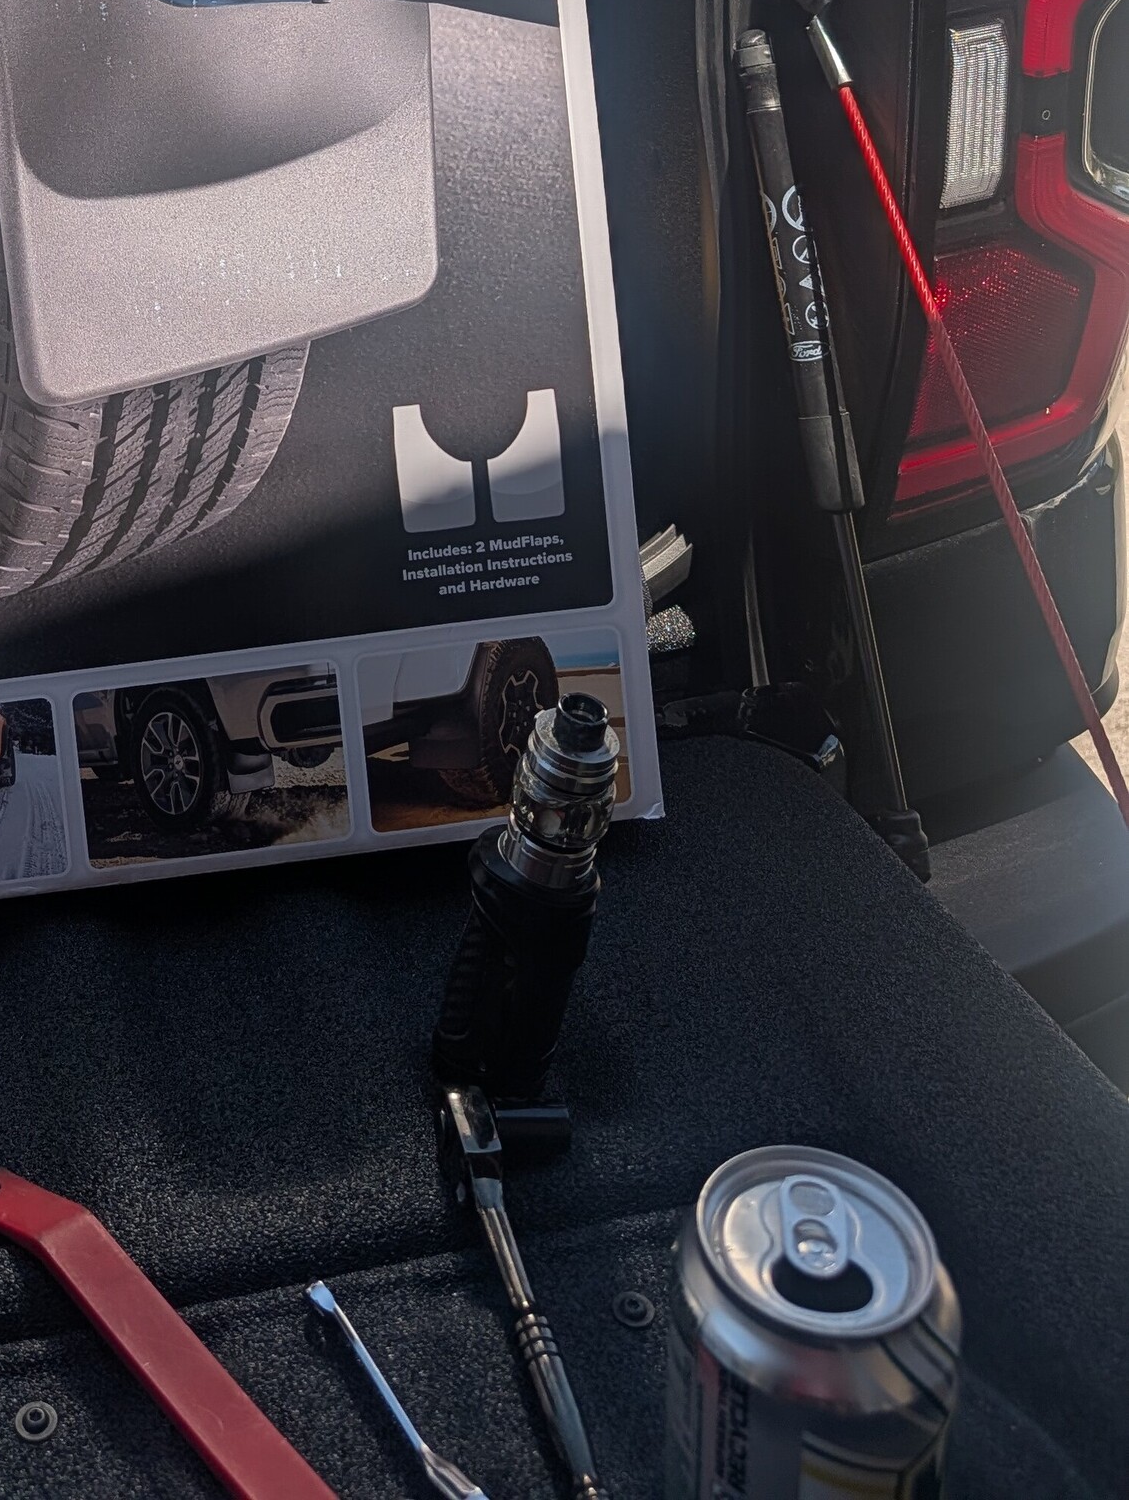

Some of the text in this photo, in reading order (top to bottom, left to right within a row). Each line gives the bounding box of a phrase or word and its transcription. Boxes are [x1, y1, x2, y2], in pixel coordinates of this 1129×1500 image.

[792, 344, 822, 358] Ford
[408, 534, 564, 561] Includes: 2 MudFlaps,
[402, 551, 573, 581] Installation Instructions
[438, 574, 540, 595] and Hardware
